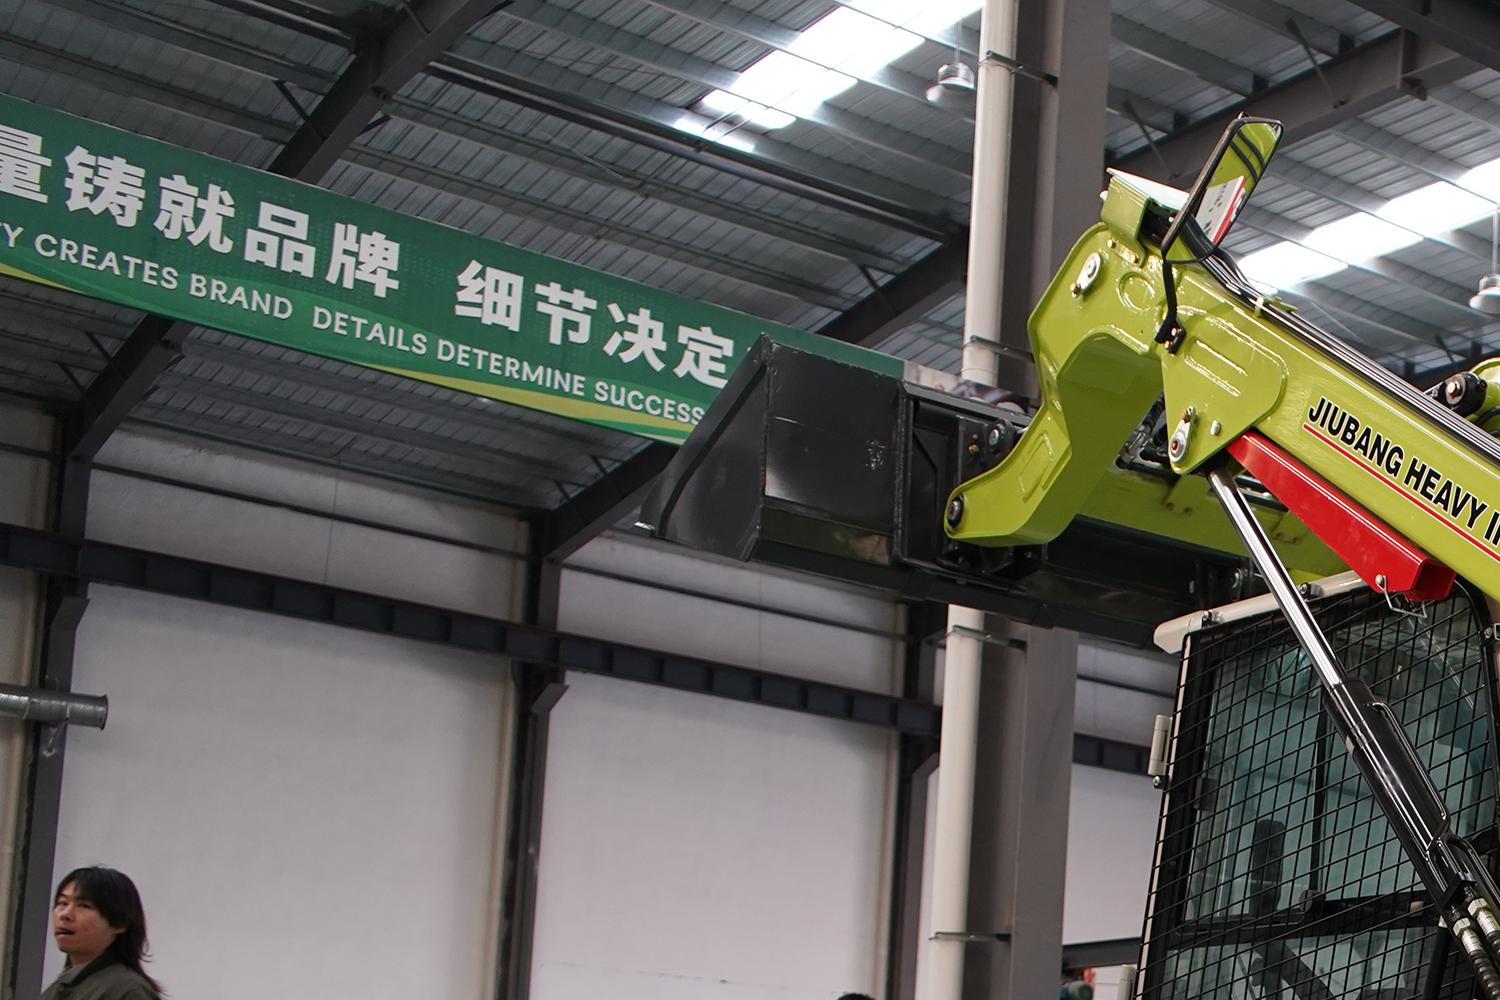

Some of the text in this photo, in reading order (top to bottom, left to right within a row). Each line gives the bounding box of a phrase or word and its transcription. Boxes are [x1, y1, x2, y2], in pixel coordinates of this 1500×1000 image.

[34, 233, 179, 290] CREATES
[189, 272, 293, 320] BRAND
[312, 305, 428, 355] DETAILS
[437, 337, 585, 397] DETERMINE
[594, 380, 705, 426] SUCCESS
[1308, 397, 1404, 477] JIUBANG
[1404, 457, 1487, 529] HEAVY
